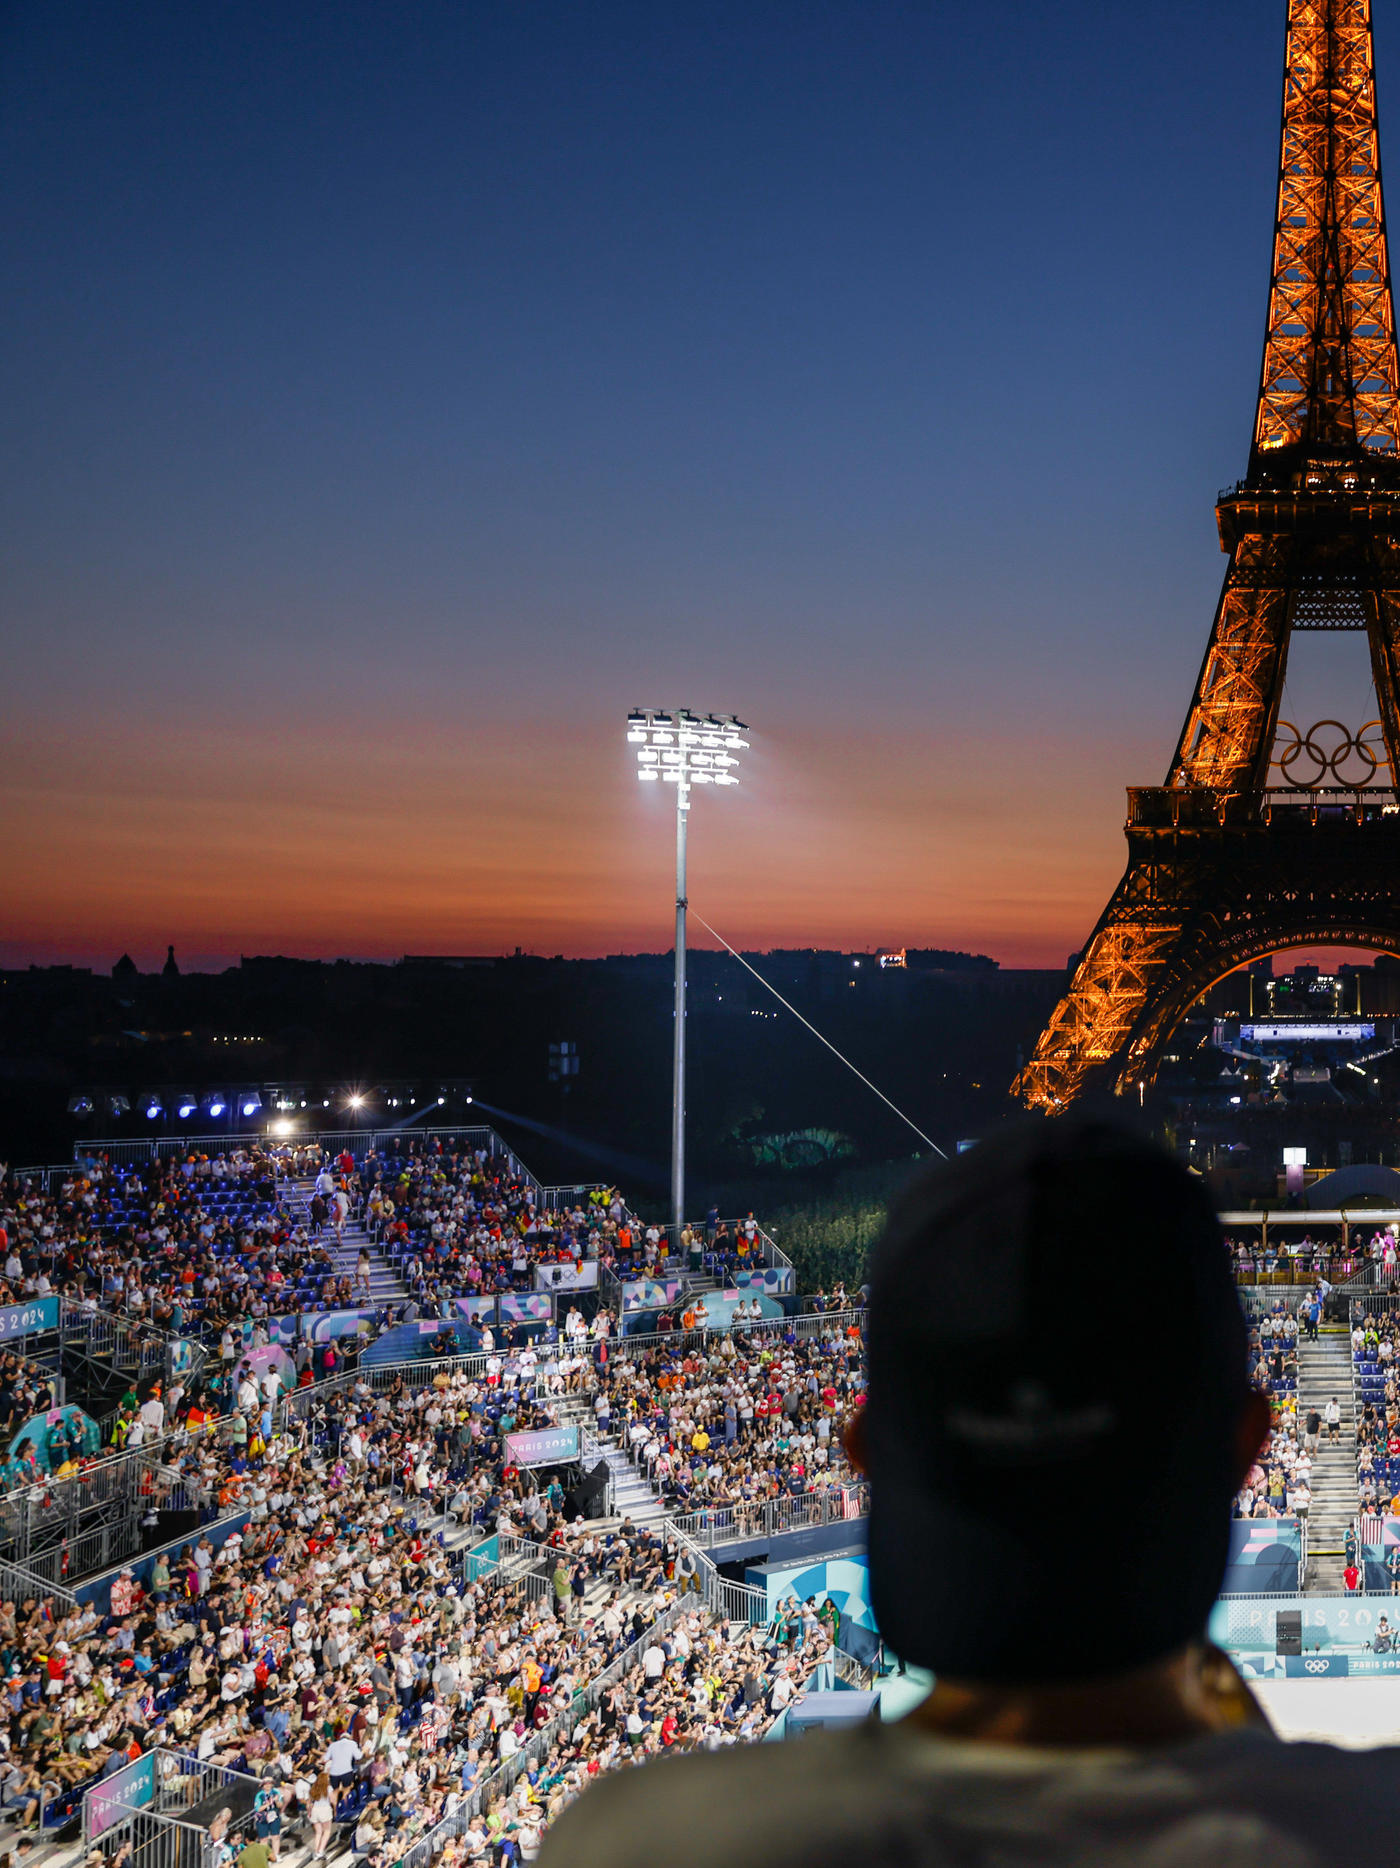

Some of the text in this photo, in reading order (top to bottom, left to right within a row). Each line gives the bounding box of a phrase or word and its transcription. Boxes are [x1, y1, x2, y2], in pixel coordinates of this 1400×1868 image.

[11, 1308, 45, 1330] 2024
[512, 1437, 573, 1454] PARIS 2024
[1250, 1608, 1327, 1628] PAIS
[1353, 1660, 1380, 1669] PARIS
[124, 1774, 150, 1799] 2024
